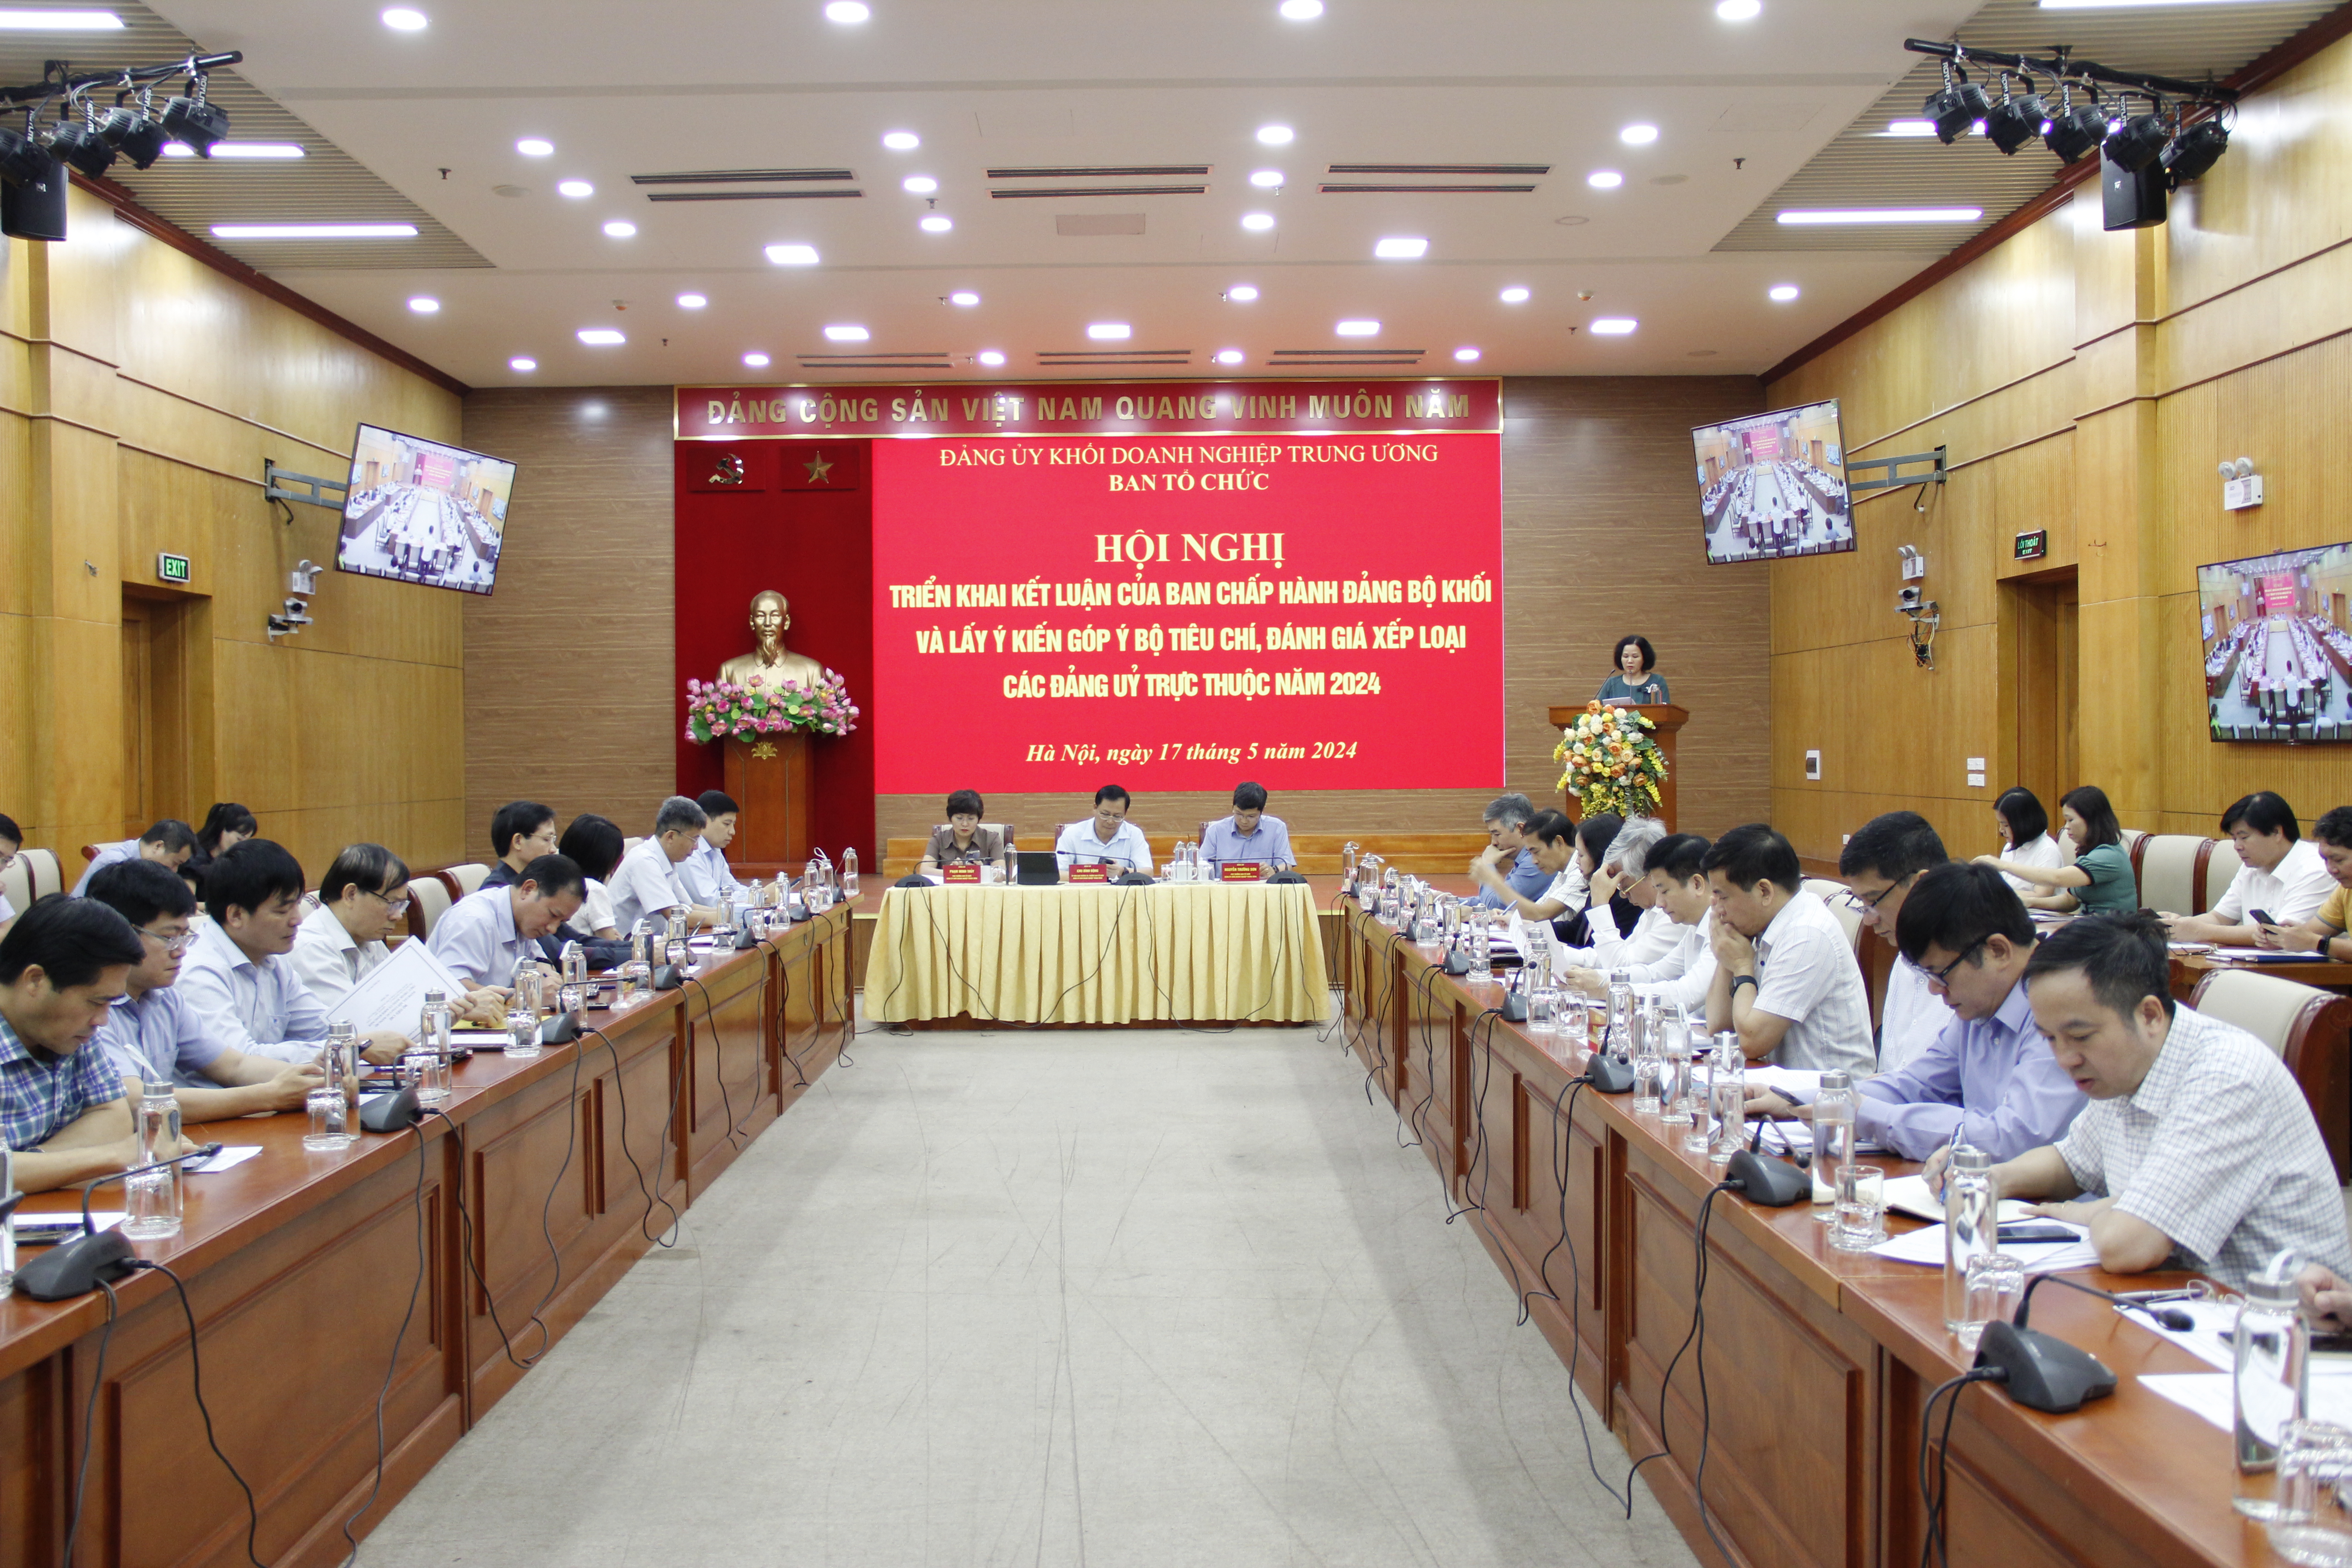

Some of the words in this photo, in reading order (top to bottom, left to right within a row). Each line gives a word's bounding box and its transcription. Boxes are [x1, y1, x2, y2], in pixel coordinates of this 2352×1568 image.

[198, 75, 207, 108] ROYLITE
[1942, 62, 1952, 95] ROYLITE
[707, 391, 786, 424] ĐẢNG
[799, 393, 878, 429] CỘNG
[892, 390, 949, 422] SẢN
[963, 392, 1024, 428] VIỆT
[1038, 397, 1103, 421] NAM
[1116, 395, 1216, 421] QUANG
[1230, 395, 1296, 420] VINH
[1309, 389, 1393, 419] MUÔN
[1406, 388, 1470, 419] NĂM
[940, 444, 1005, 466] ĐẢNG
[1012, 444, 1044, 465] ỦY
[1049, 442, 1105, 465] KHỐI
[1112, 446, 1192, 464] DOANH
[1199, 443, 1281, 466] NGHIỆP
[1287, 445, 1365, 462] TRUNG
[1372, 443, 1438, 462] ƯƠNG
[1109, 474, 1156, 491] BAN
[1162, 469, 1195, 491] TỔ
[1201, 469, 1269, 490] CHỨC
[1095, 529, 1170, 570] HỘI
[1181, 533, 1285, 568] NGHỊ
[2025, 536, 2039, 548] THOÁT
[166, 558, 186, 577] EXIT
[889, 575, 951, 608] TRIỂN
[956, 584, 1006, 607] KHAI
[1012, 575, 1051, 607] KẾT
[1056, 578, 1111, 611] LUẬN
[1117, 573, 1161, 606] CỦA
[1166, 582, 1210, 605] BAN
[1216, 573, 1274, 605] CHẤP
[1279, 576, 1338, 604] HÀNH
[1343, 571, 1402, 603] ĐẢNG
[1408, 575, 1436, 608] BỘ
[1442, 571, 1491, 603] KHỐI
[916, 626, 944, 653] VÀ
[950, 622, 988, 653] LẤY
[993, 625, 1006, 652] Ý
[1012, 621, 1062, 652] KIẾN
[1068, 624, 1110, 652] GÓP
[1116, 624, 1129, 652] Ý
[1135, 623, 1163, 657] BỘ
[1168, 623, 1214, 651] TIÊU
[1220, 622, 1261, 653] CHÍ,
[1266, 622, 1326, 650] ĐÁNH
[1332, 621, 1367, 650] GIÁ
[1372, 617, 1414, 649] XẾP
[1420, 625, 1465, 653] LOẠI
[1004, 670, 1045, 698] CÁC
[1050, 664, 1108, 698] ĐẢNG
[1113, 664, 1140, 697] UỶ
[1144, 671, 1198, 701] TRỰC
[1202, 668, 1270, 701] THUỘC
[1275, 667, 1325, 696] NĂM
[1330, 671, 1381, 695] 2024
[1026, 744, 1055, 761] Hà
[1061, 744, 1100, 766] Nội,
[1107, 744, 1152, 765] ngày
[1159, 743, 1182, 760] 17
[1186, 743, 1241, 764] tháng
[1247, 742, 1258, 760] 5
[1264, 743, 1305, 759] năm
[1311, 741, 1357, 759] 2024
